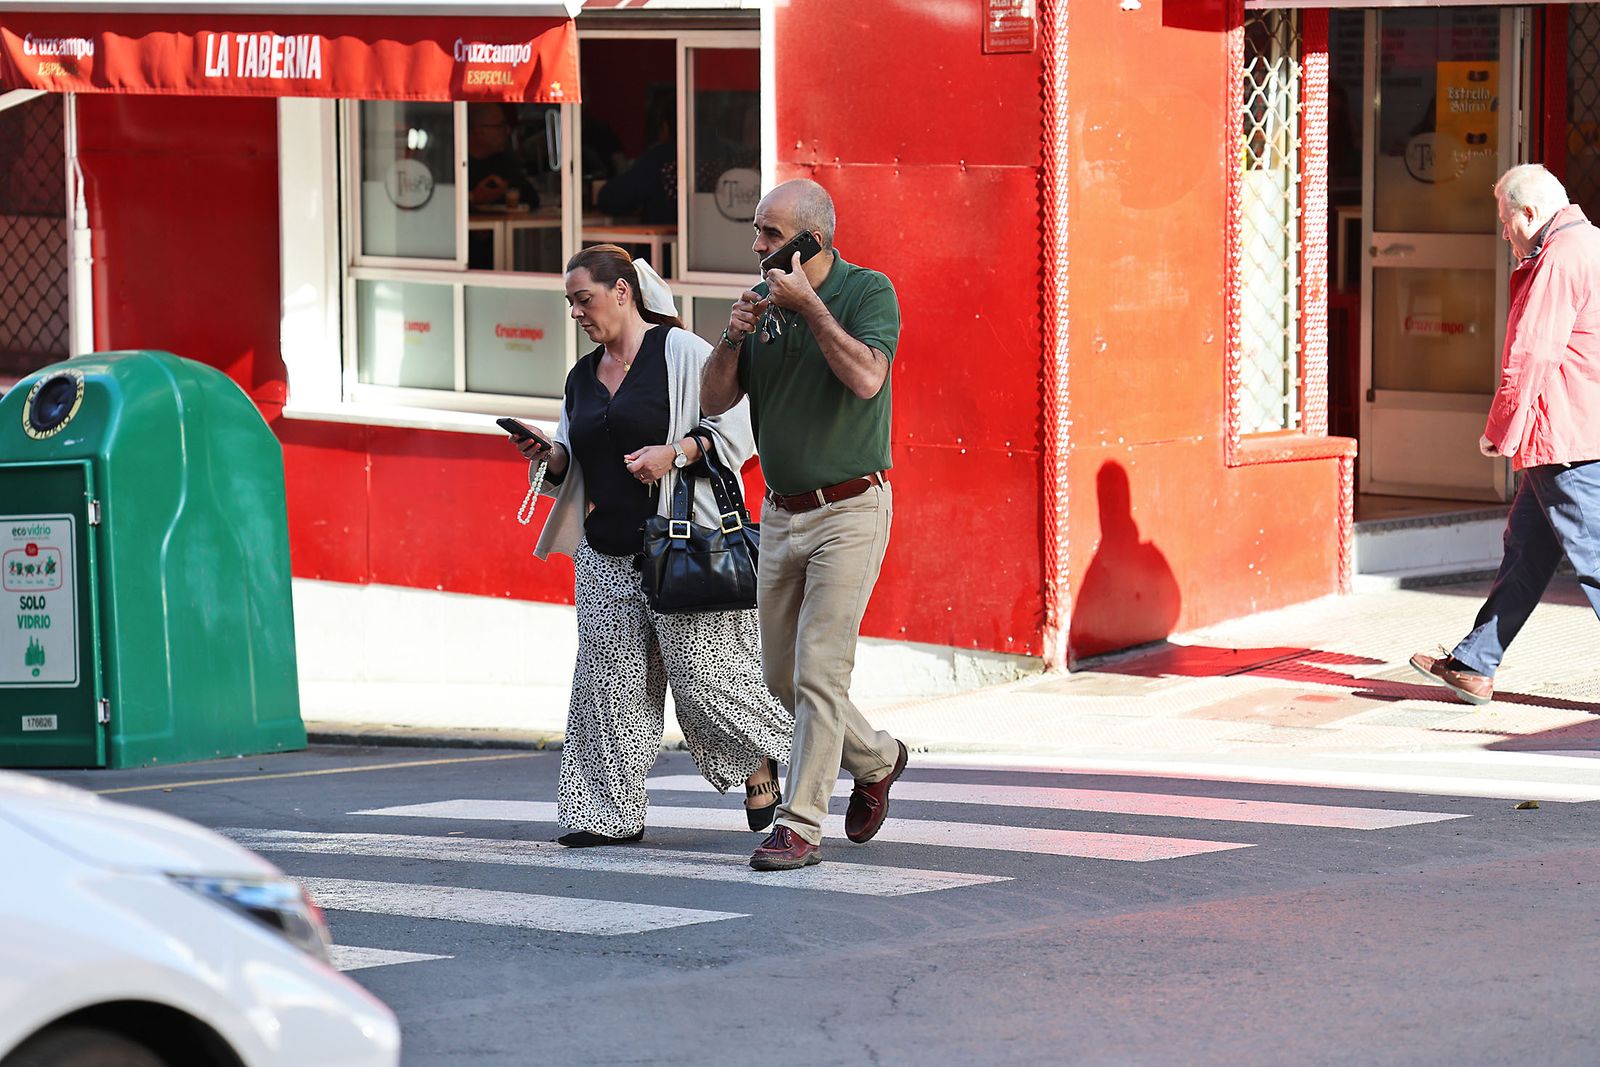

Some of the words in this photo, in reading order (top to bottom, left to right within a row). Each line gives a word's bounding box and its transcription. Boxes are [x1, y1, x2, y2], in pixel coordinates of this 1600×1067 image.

[23, 33, 94, 60] Cruzcampo
[205, 33, 229, 77] LA
[236, 33, 321, 79] TABERNA
[454, 38, 530, 67] Cruzcampo
[467, 69, 514, 85] ESPECIAL
[20, 595, 46, 610] SOLO
[17, 614, 51, 629] VIDRIO
